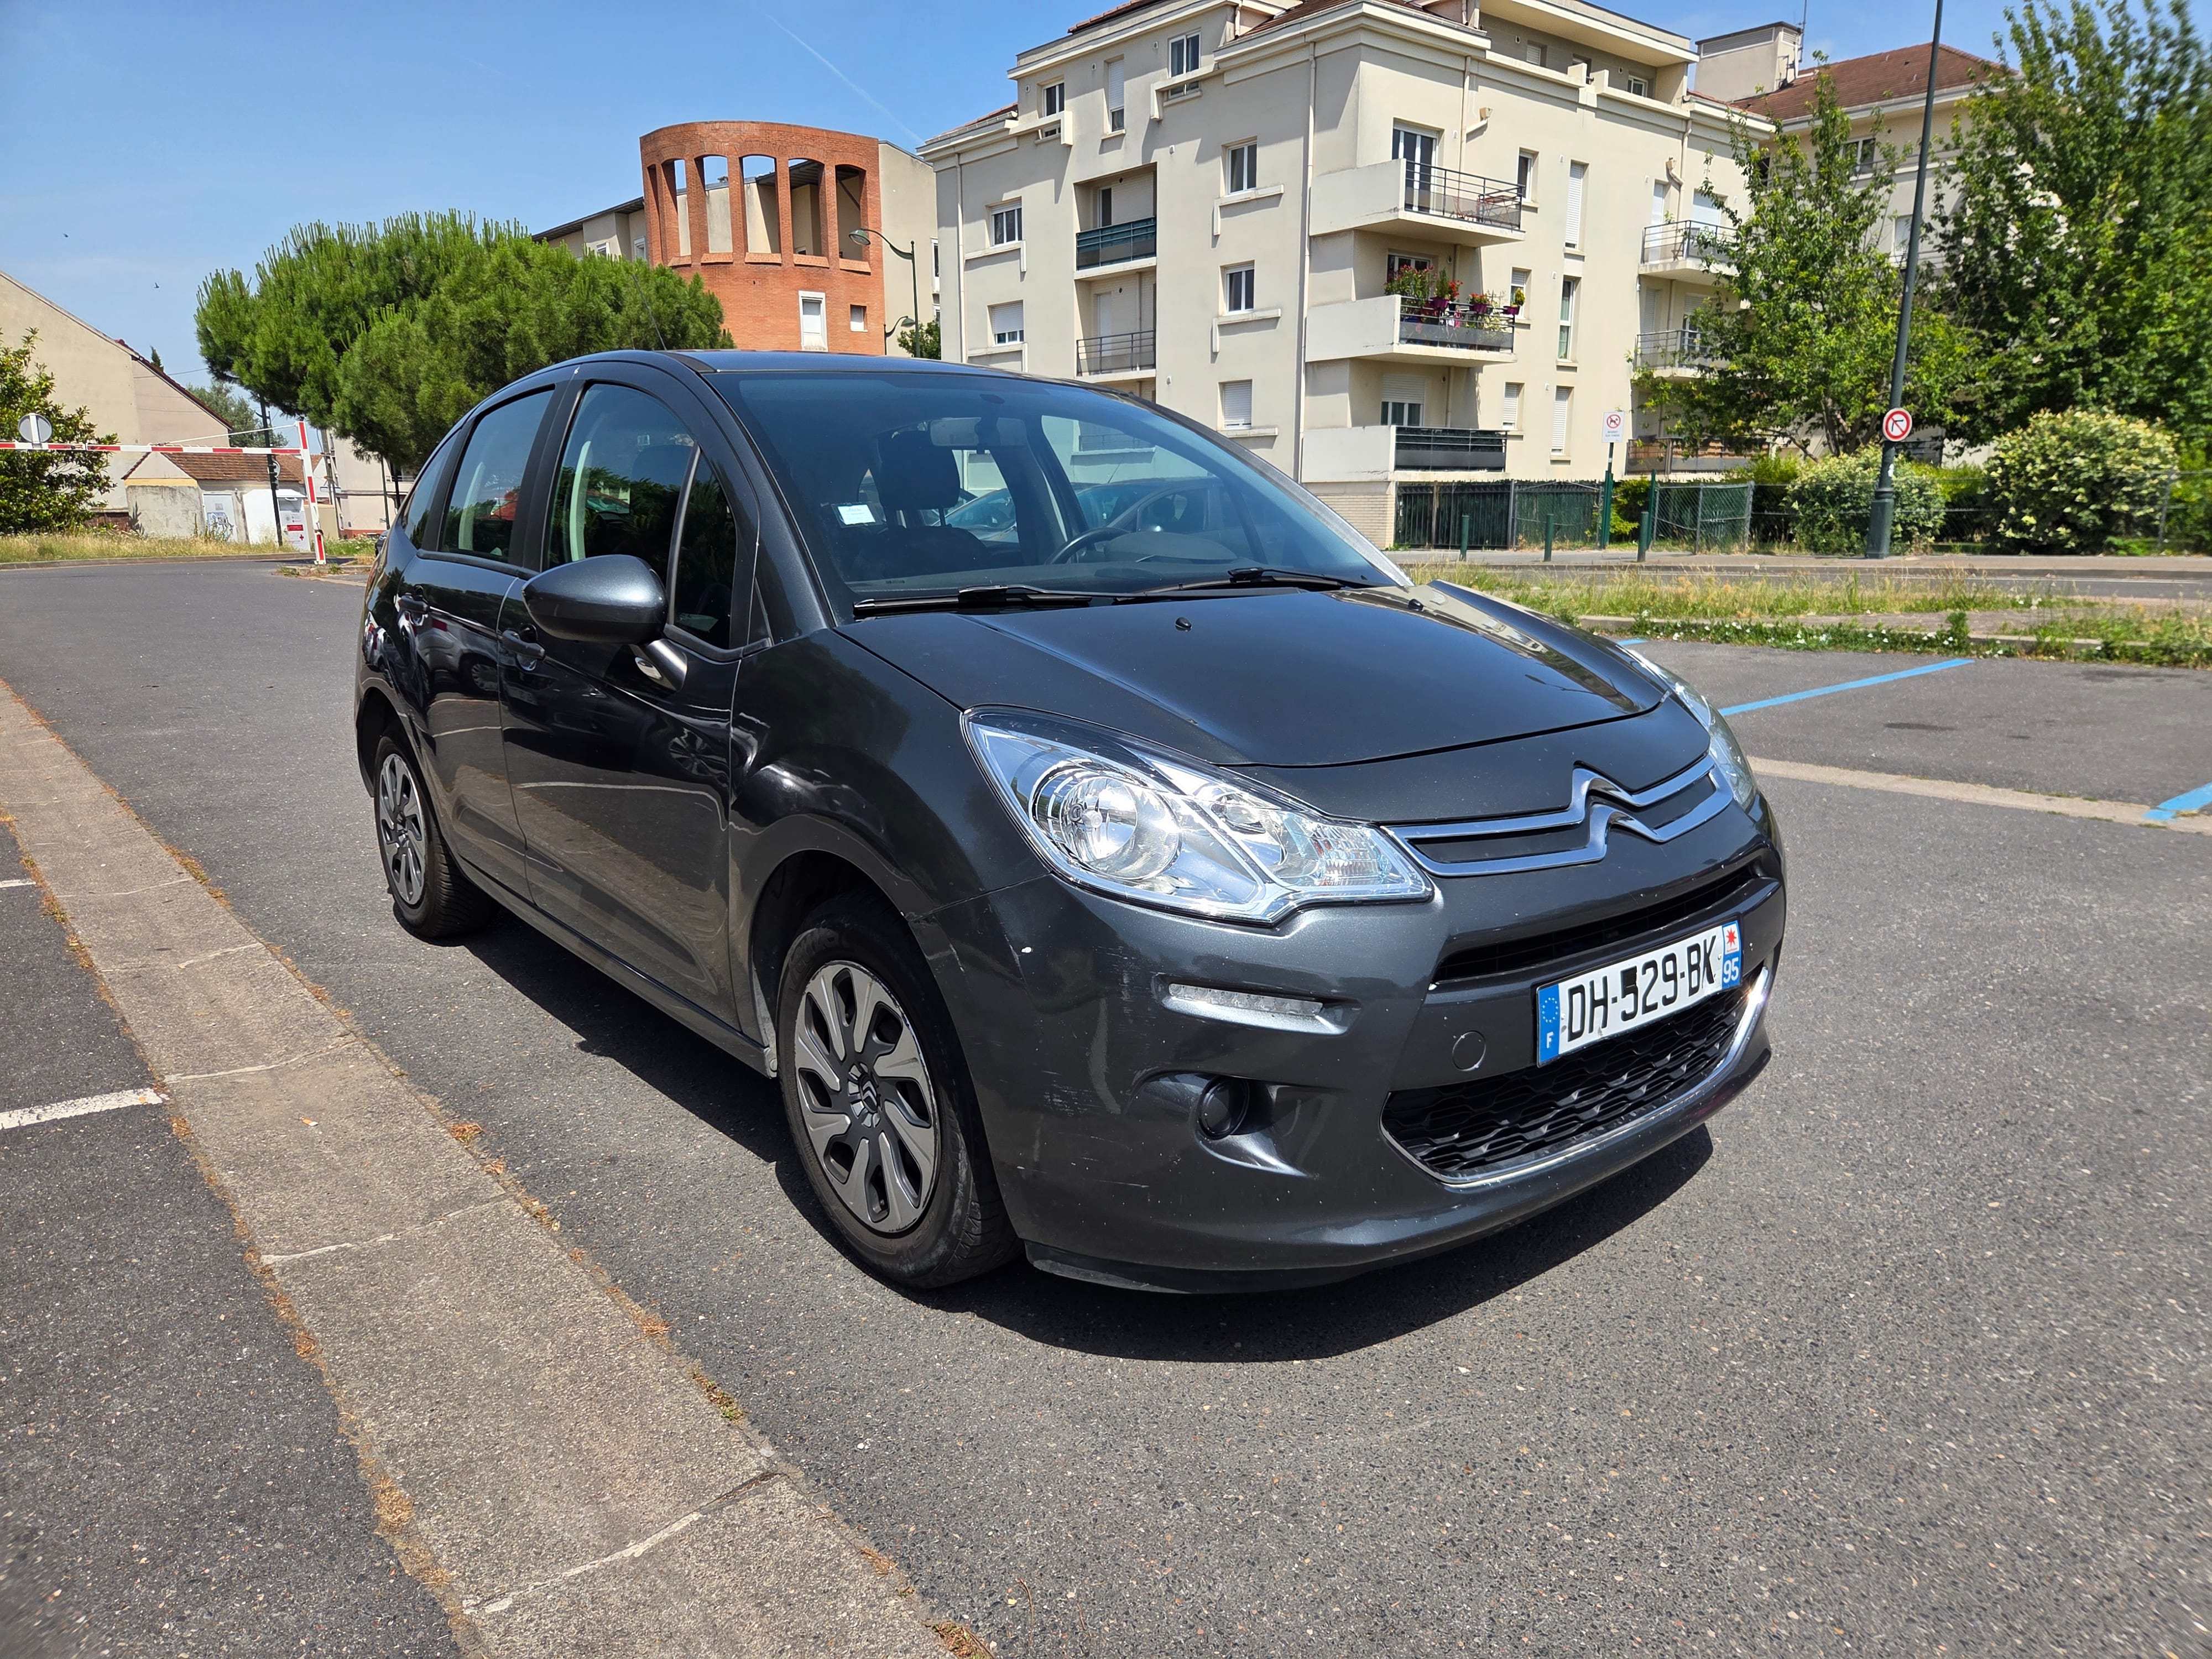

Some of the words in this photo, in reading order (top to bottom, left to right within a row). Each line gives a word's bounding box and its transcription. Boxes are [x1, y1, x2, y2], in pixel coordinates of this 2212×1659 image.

[1723, 957, 1739, 983] 95
[1567, 935, 1717, 1042] DH-529-BK
[1547, 1031, 1554, 1048] F
